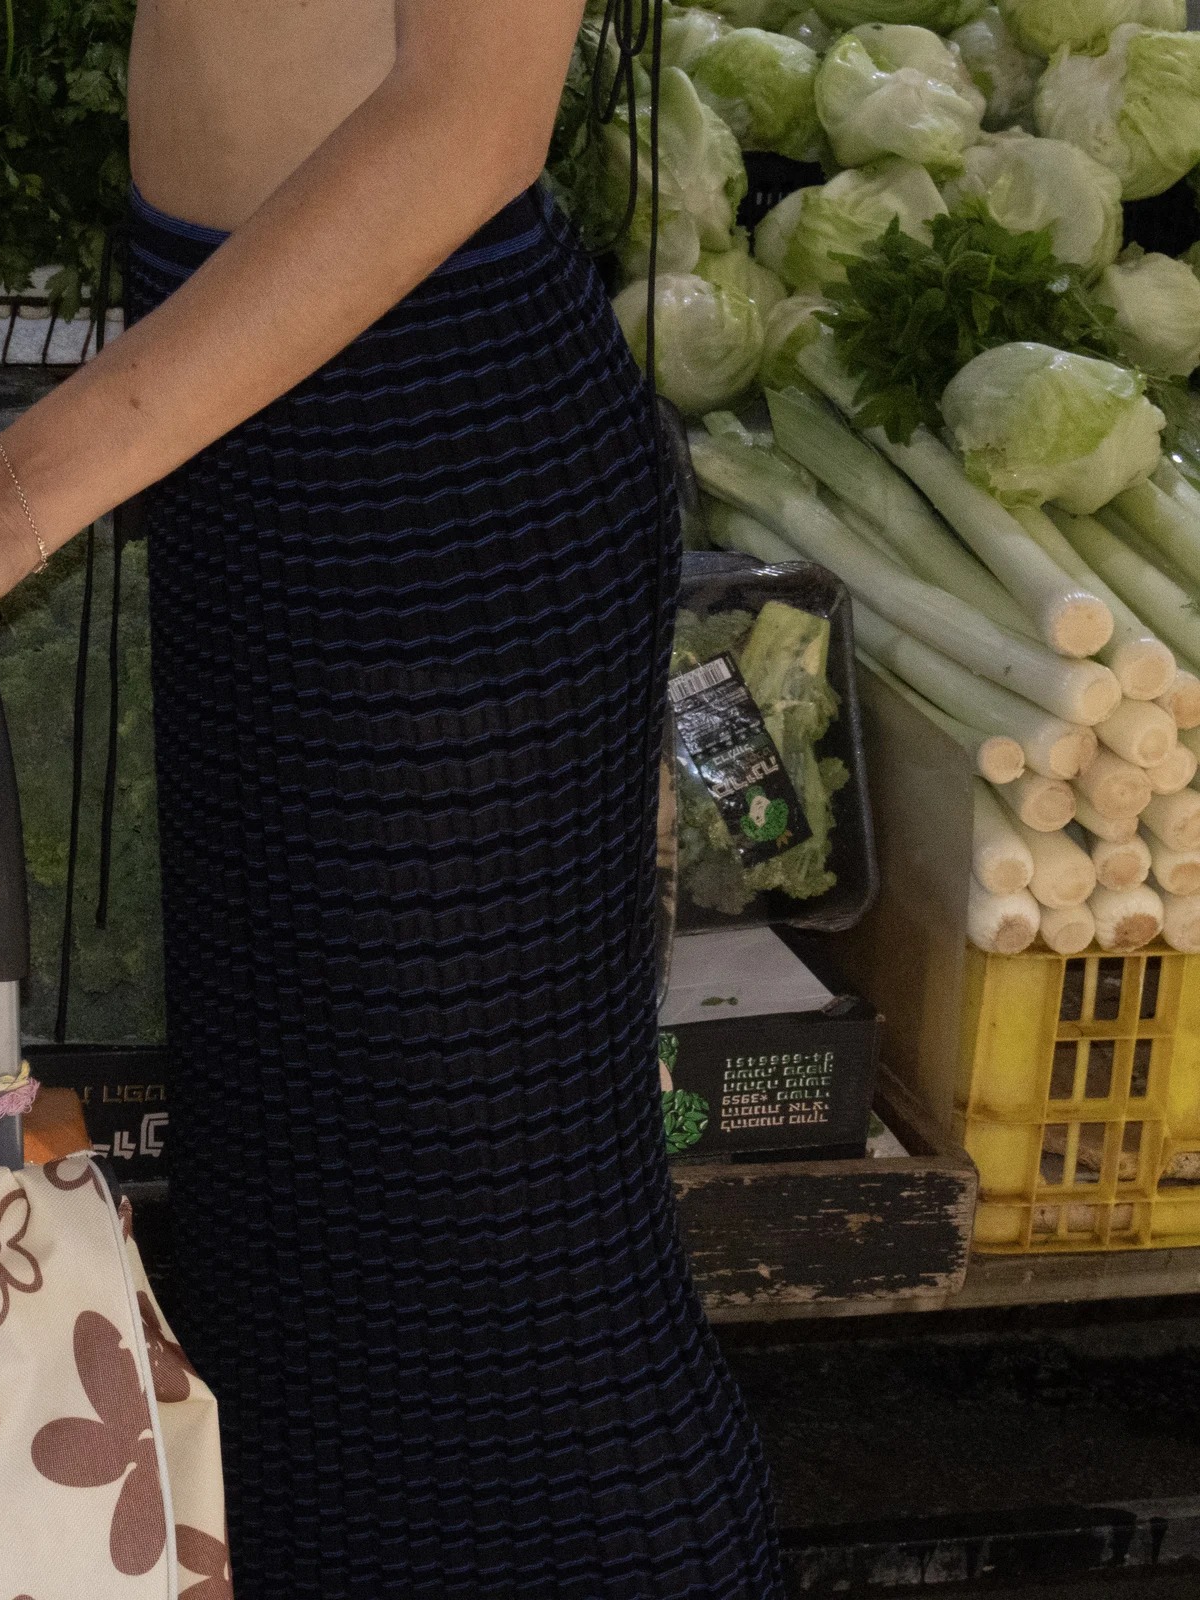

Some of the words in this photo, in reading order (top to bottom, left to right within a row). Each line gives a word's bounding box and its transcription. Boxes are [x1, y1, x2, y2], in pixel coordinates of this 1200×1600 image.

[724, 1080, 779, 1093] הנהלה
[785, 1076, 832, 1088] מושב
[777, 1089, 830, 1100] משרדי
[722, 1104, 781, 1117] הזמנות
[789, 1101, 829, 1112] ארצי
[721, 1116, 785, 1132] להזמנות
[789, 1110, 828, 1124] מוקד
